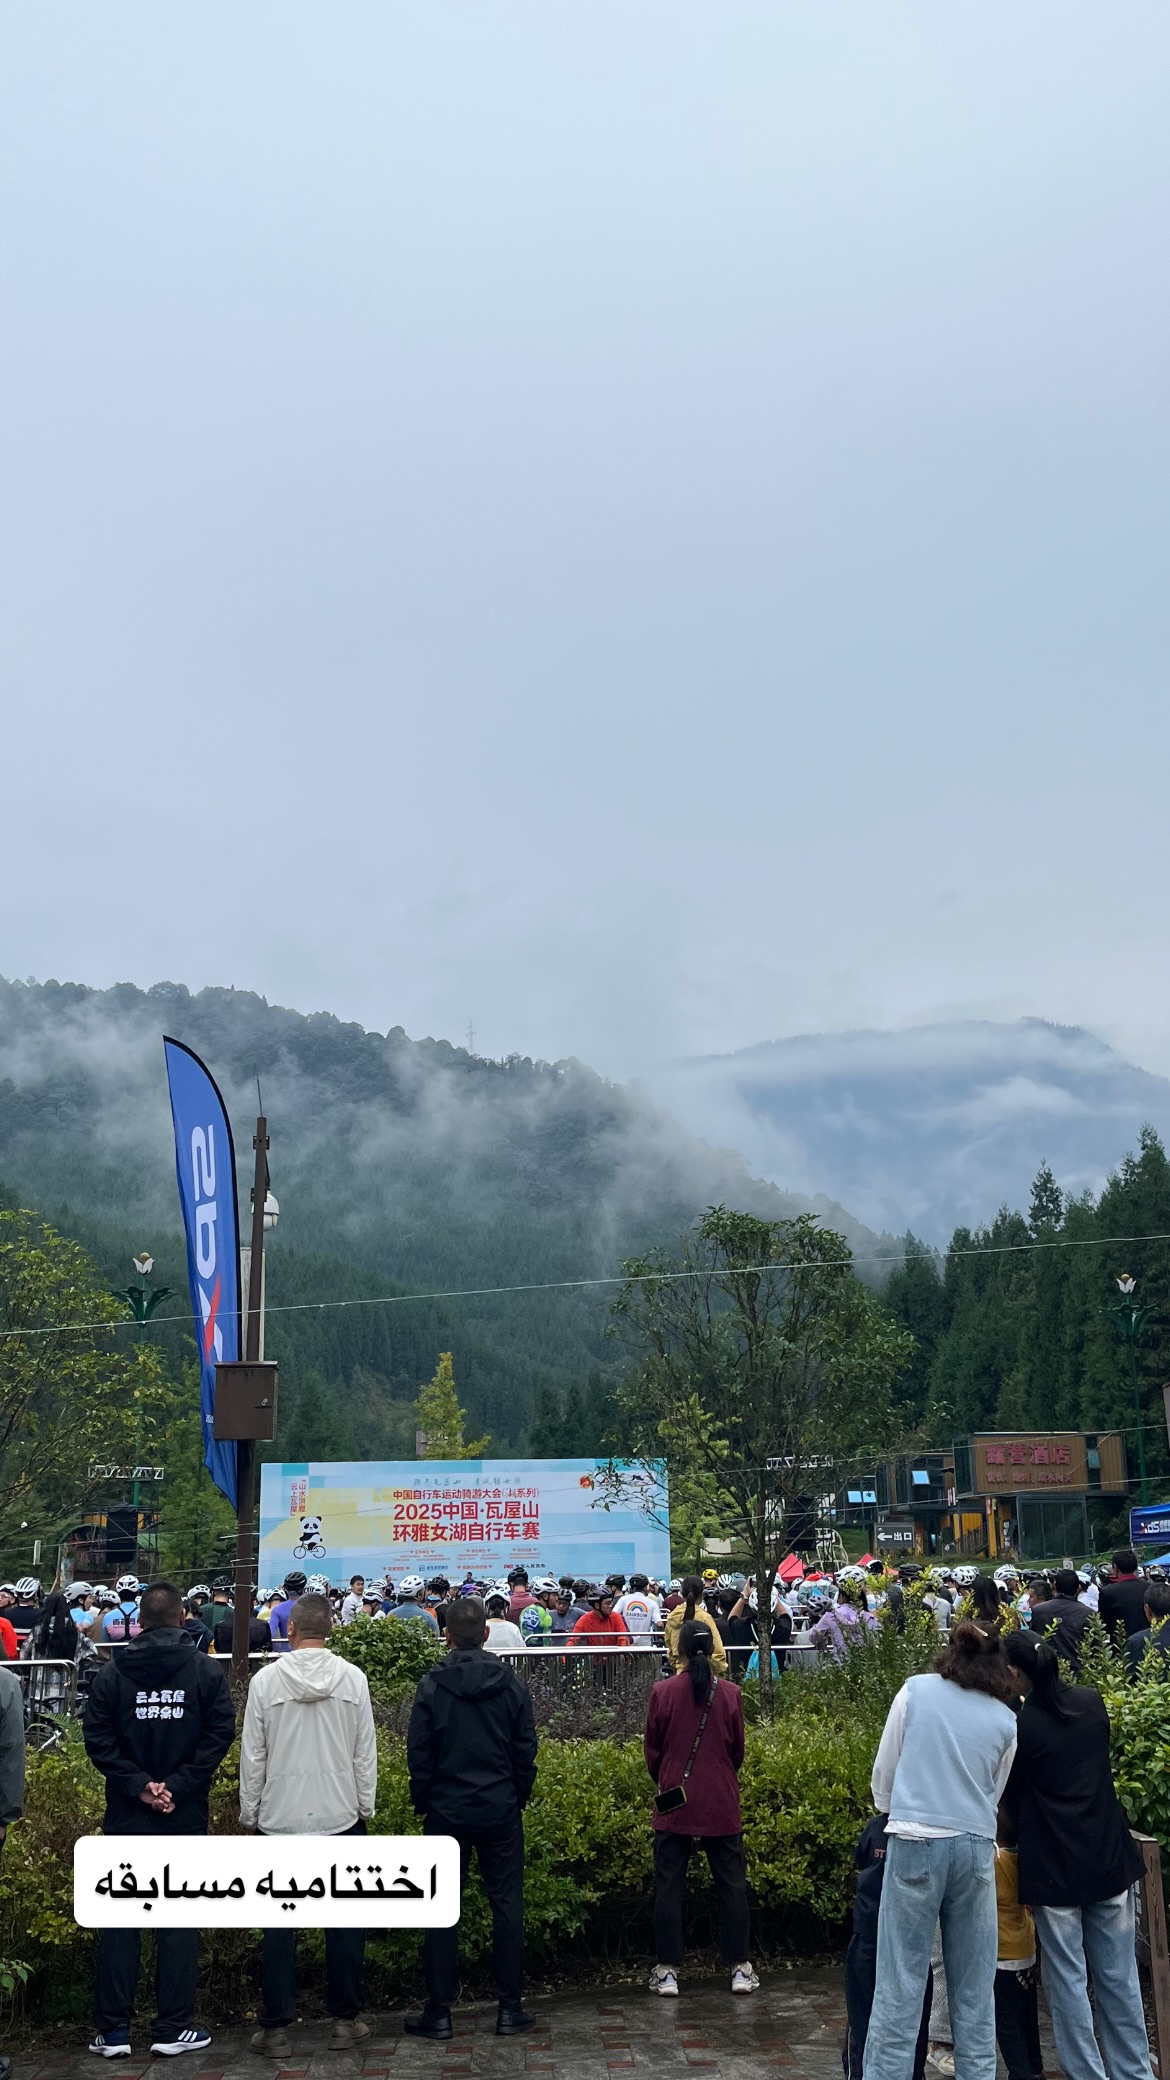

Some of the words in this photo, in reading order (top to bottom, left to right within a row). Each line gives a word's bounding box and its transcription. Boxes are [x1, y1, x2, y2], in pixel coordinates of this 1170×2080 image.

[985, 1443, 1071, 1465] 露营酒店
[393, 1500, 539, 1521] 2025中国·瓦屋山
[393, 1521, 540, 1543] 环雅女湖自行车赛
[893, 1532, 912, 1542] 出口
[135, 1689, 185, 1704] 云上瓦屋
